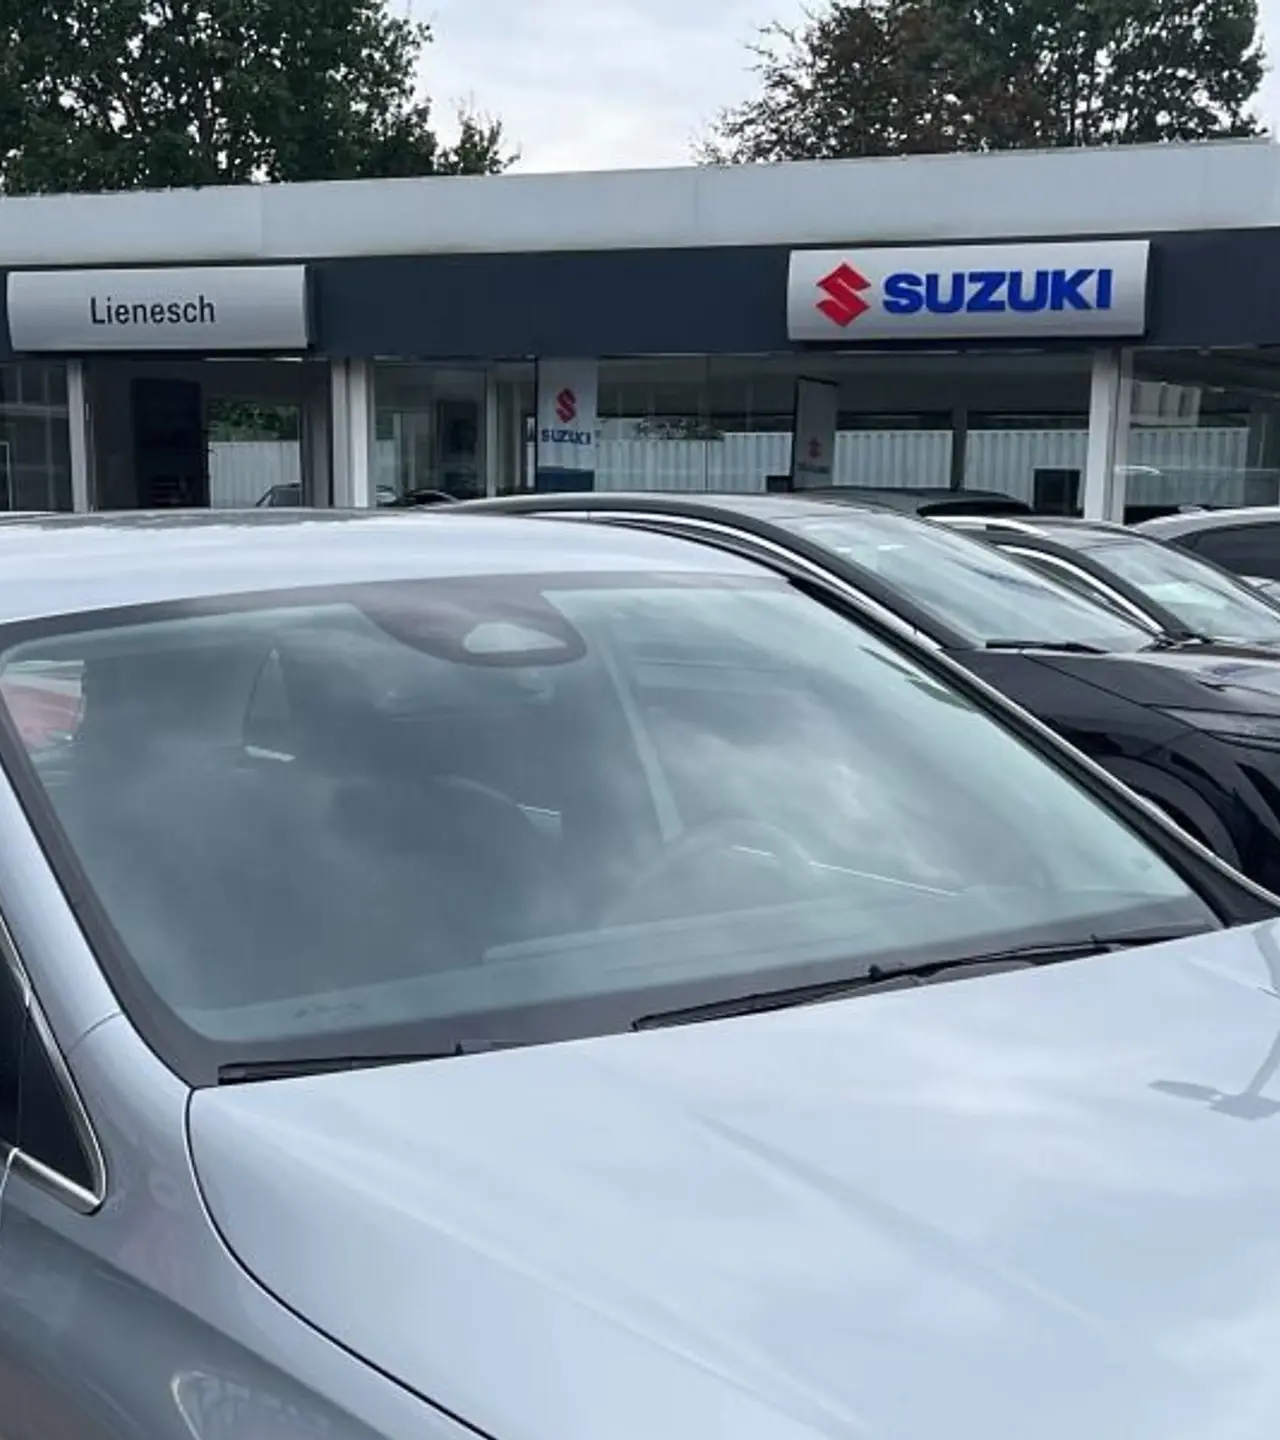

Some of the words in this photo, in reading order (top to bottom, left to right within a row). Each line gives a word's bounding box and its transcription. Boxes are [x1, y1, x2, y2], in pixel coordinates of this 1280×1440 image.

[882, 269, 1113, 314] SUZUKI
[89, 294, 216, 325] Lienesch
[540, 428, 592, 445] SUZUKI
